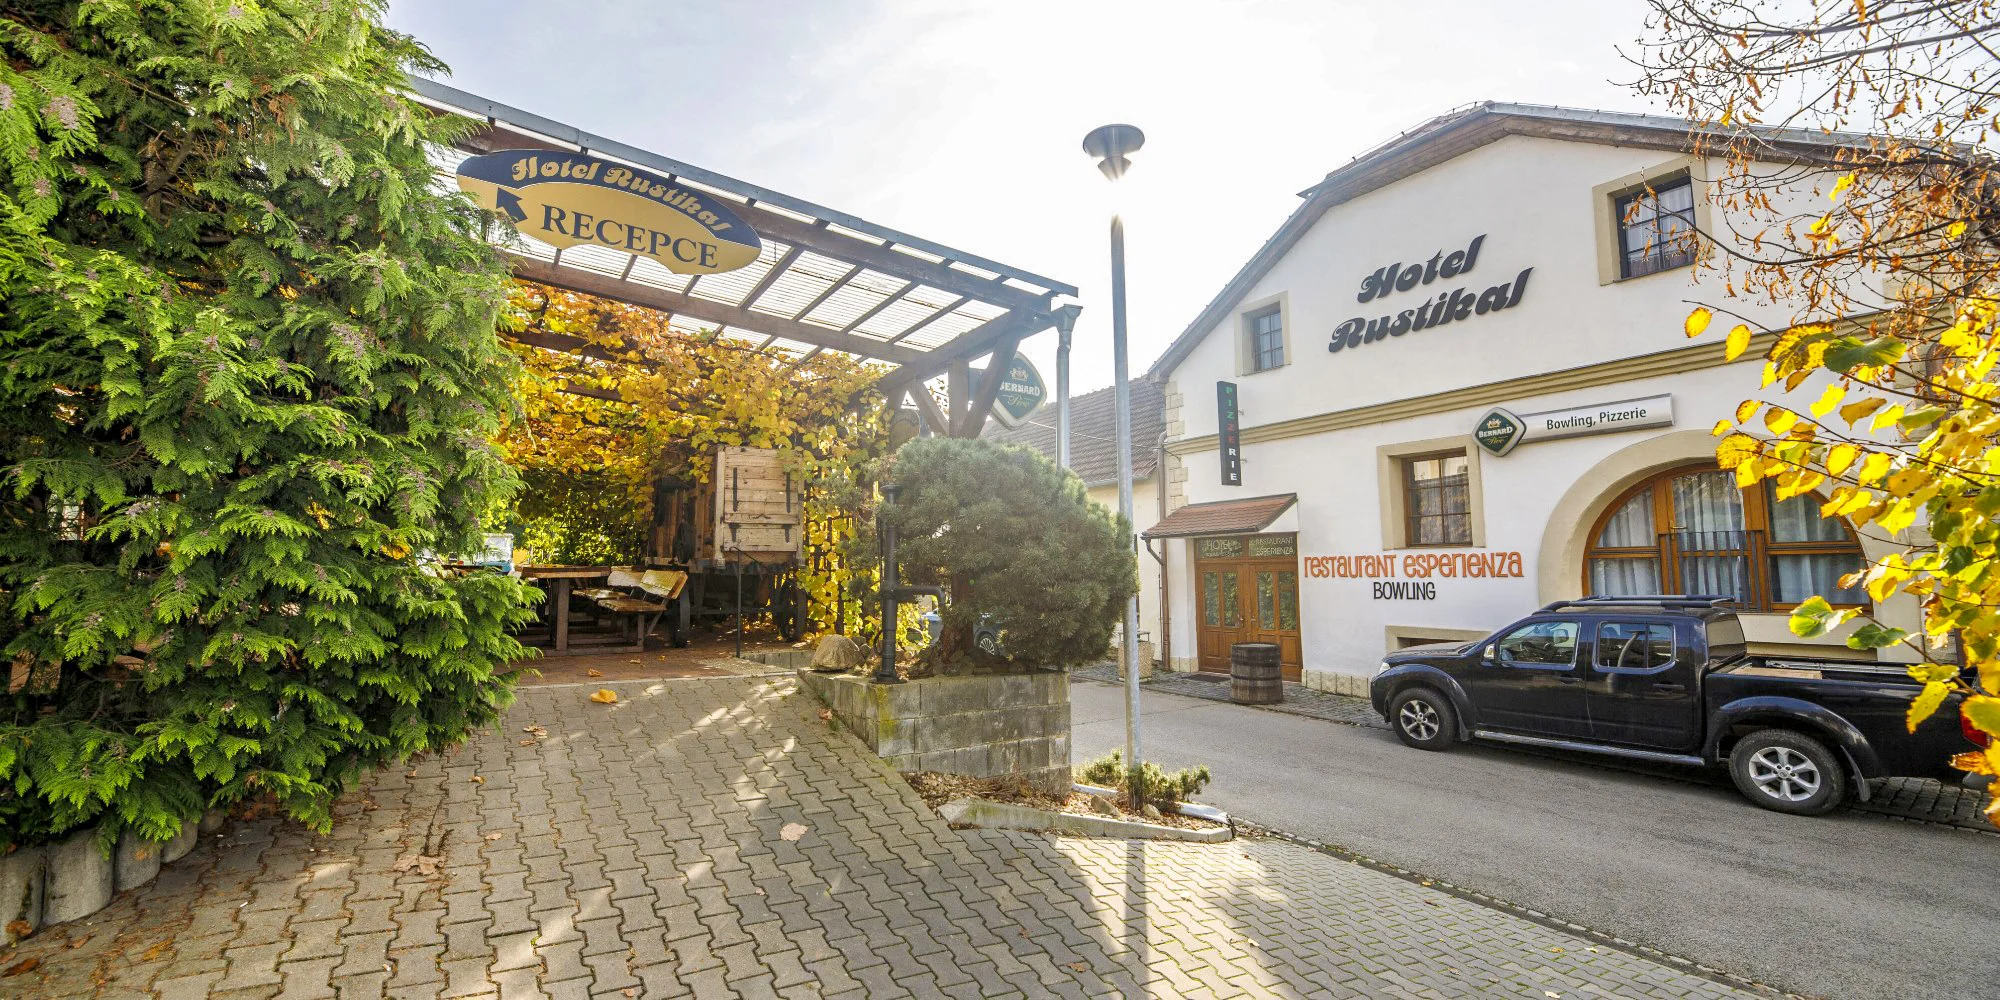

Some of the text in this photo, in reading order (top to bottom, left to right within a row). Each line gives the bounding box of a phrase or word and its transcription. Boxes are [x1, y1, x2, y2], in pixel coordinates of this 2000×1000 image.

[511, 156, 734, 232] Hotel Rustikal
[540, 203, 719, 269] RECEPCE
[1357, 233, 1487, 303] Hotel
[1328, 266, 1534, 353] Rustikal
[1225, 386, 1238, 481] PIZZERIE
[1478, 426, 1514, 438] BERNARD
[1546, 407, 1647, 430] Bowling, Pizzerie
[1206, 539, 1232, 552] HOTEL
[1373, 581, 1436, 600] BOWLING
